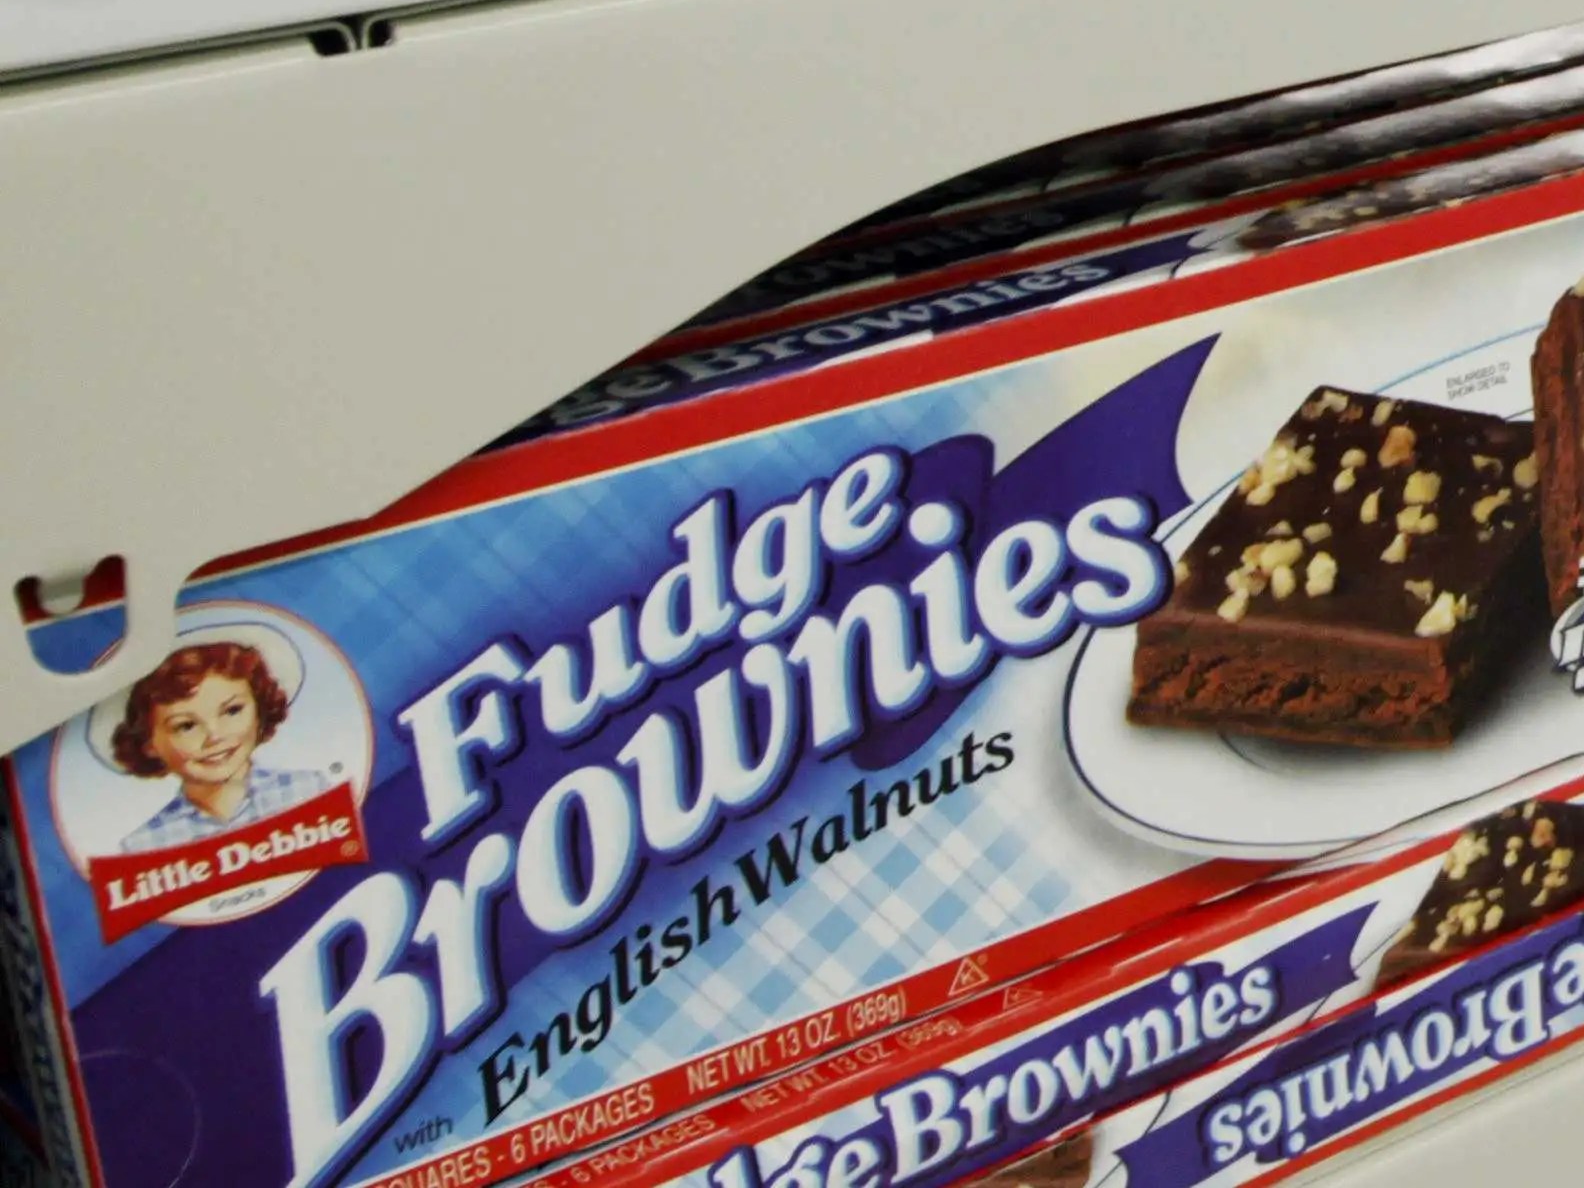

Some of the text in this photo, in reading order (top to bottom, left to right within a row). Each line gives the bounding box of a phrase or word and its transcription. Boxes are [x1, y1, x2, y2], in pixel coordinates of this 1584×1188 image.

[678, 260, 1111, 383] Brownies
[399, 450, 901, 841] Fudge
[106, 815, 352, 911] Little Debbie
[259, 496, 1163, 1188] Brownies
[375, 1145, 492, 1188] UARES
[510, 1132, 526, 1164] 6
[529, 1082, 656, 1156] PACKAGES
[687, 1050, 731, 1095] NET
[776, 1030, 801, 1059] 13
[846, 989, 907, 1038] (369g)
[393, 1115, 454, 1154] with
[570, 1167, 591, 1185] 6
[595, 1114, 716, 1175] PACKAGES
[739, 1084, 783, 1114] NET
[829, 1054, 854, 1077] 13
[876, 957, 1276, 1183] Brownies
[1209, 961, 1549, 1164] Brownies
